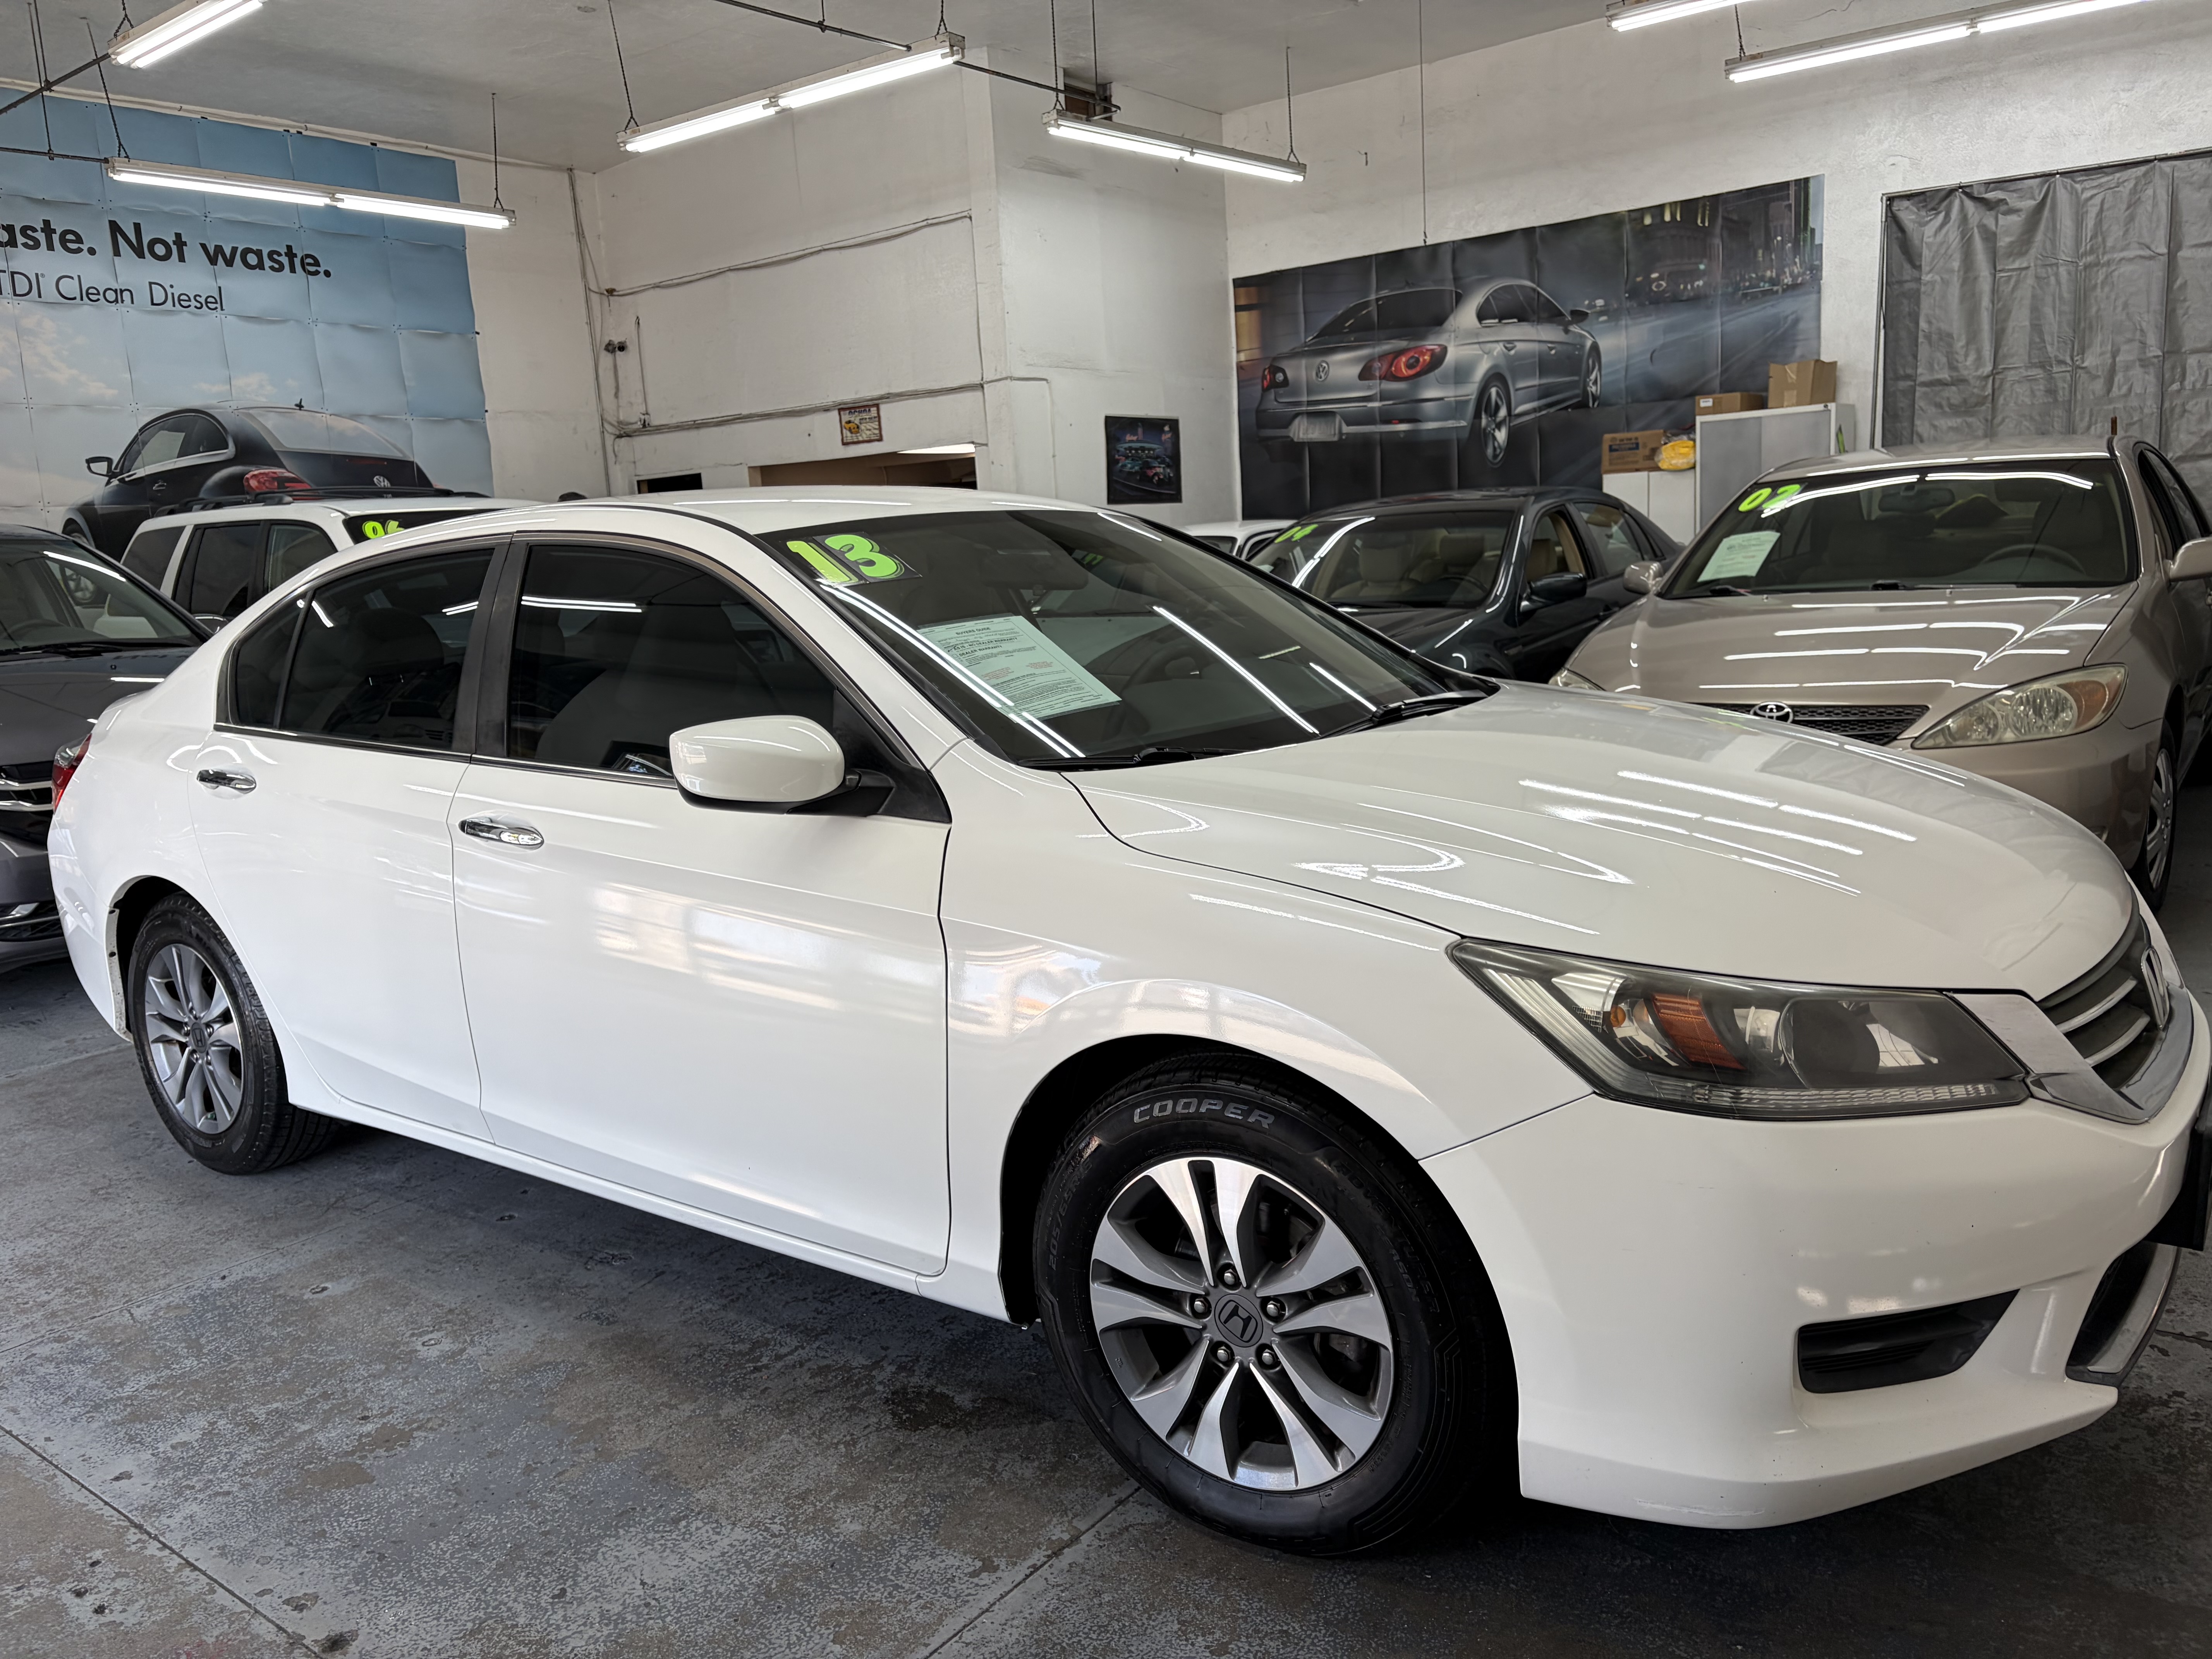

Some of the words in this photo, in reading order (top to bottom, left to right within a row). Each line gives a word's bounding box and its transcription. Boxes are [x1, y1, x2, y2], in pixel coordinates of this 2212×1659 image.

[108, 220, 187, 263] Not
[199, 242, 331, 278] waste.
[55, 275, 134, 305] Clean
[148, 282, 224, 311] Diesel
[787, 534, 902, 582] 13
[959, 649, 978, 657] DEALER
[1134, 1097, 1275, 1129] COOPER
